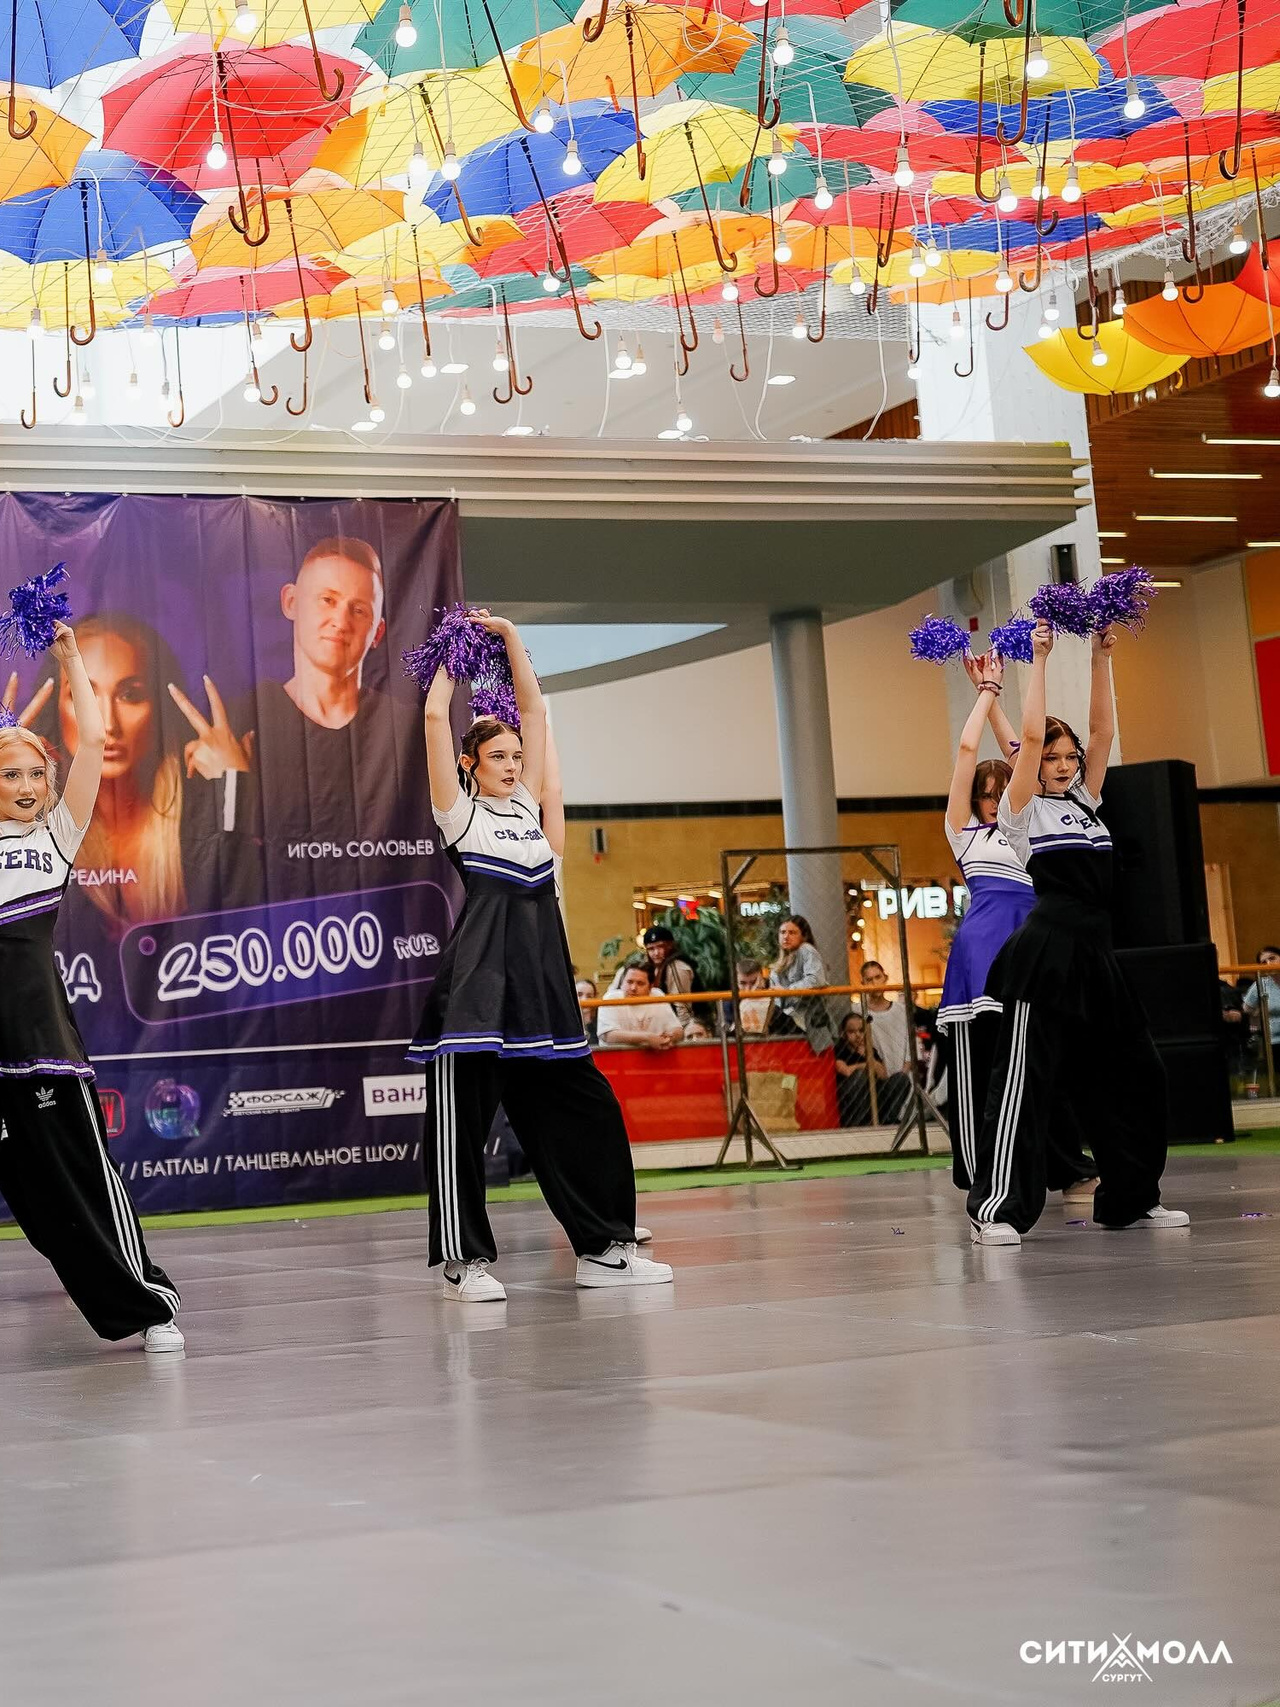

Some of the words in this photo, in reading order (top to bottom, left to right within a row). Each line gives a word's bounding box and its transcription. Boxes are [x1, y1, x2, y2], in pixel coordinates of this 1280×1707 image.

[287, 842, 342, 860] ИГОРЬ
[346, 838, 435, 858] СОЛОВЬЕВ
[157, 911, 383, 1002] 250.000
[393, 933, 440, 961] RUB
[246, 1091, 320, 1104] ФОРСАЖ
[142, 1155, 209, 1179] БАТТЛЫ
[224, 1146, 361, 1172] ТАНЦЕВАЛЬНОЕ
[365, 1143, 409, 1164] ШОУ
